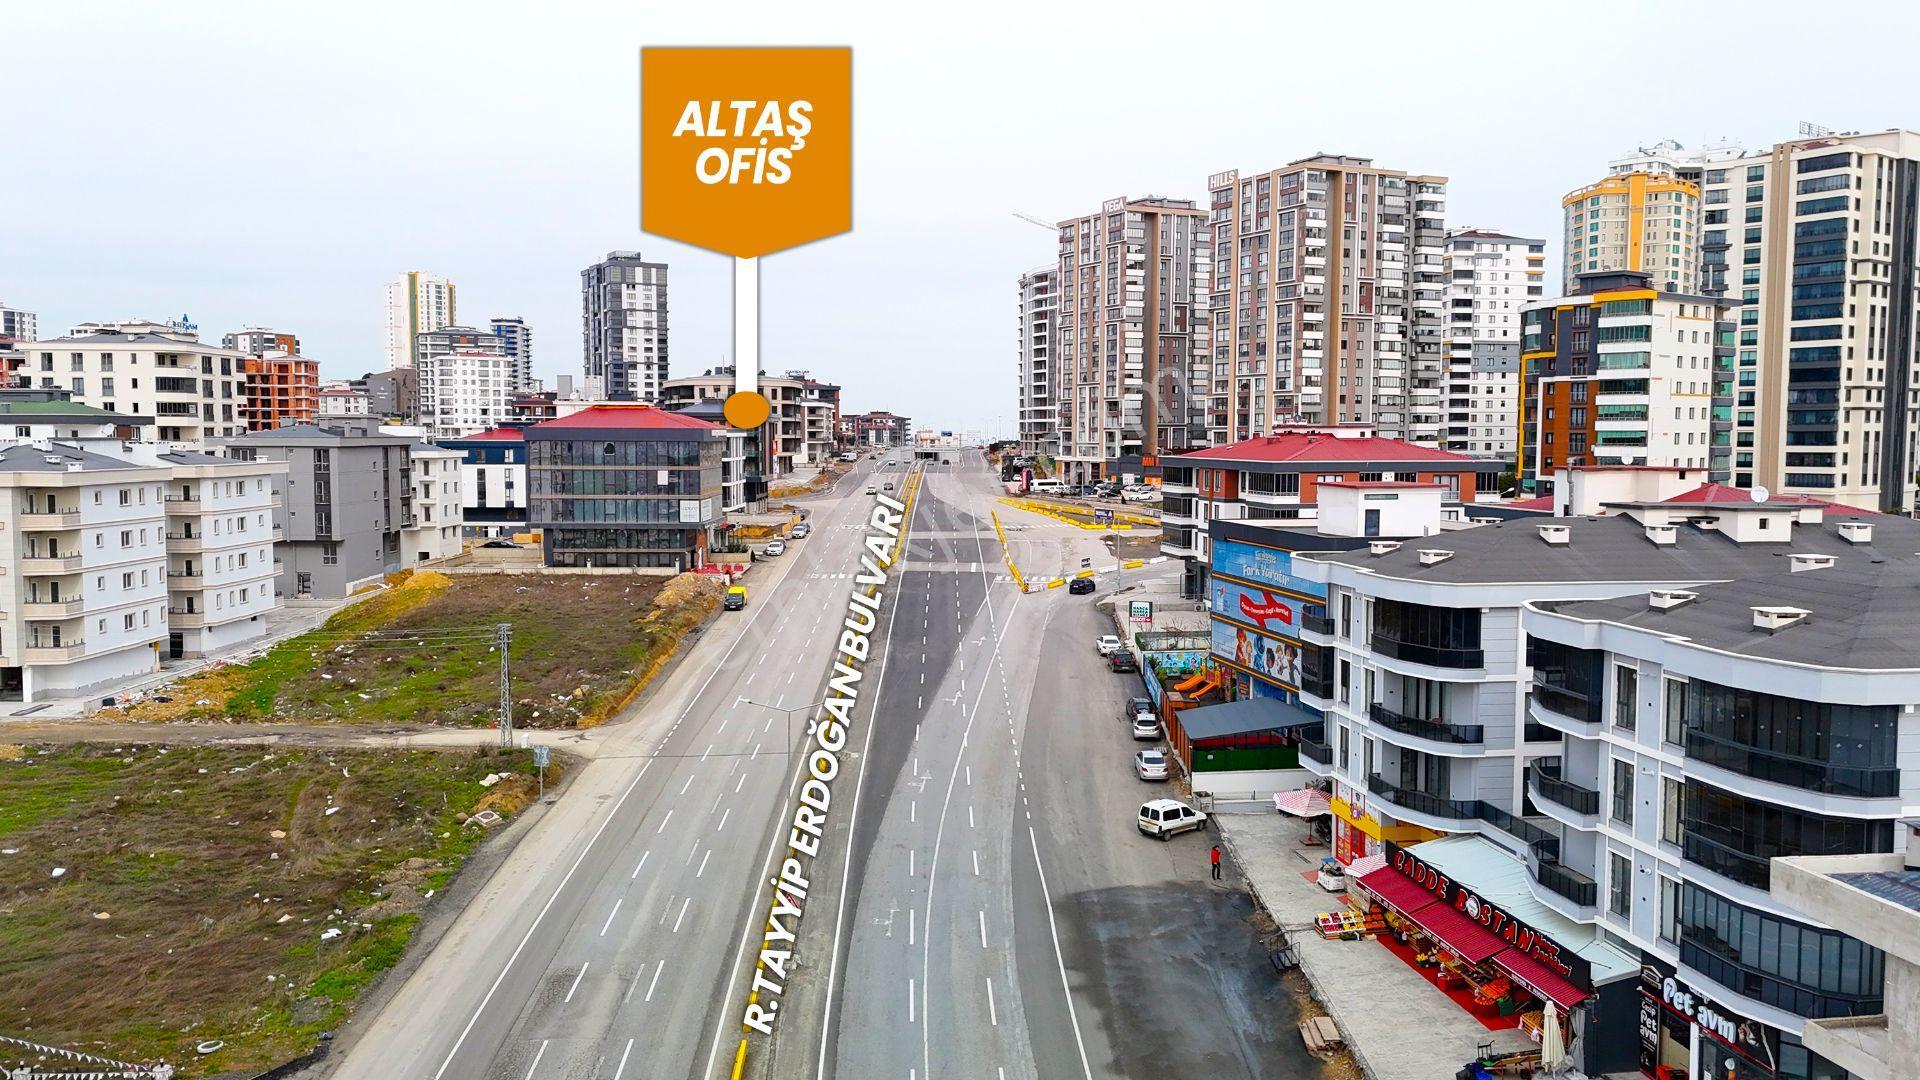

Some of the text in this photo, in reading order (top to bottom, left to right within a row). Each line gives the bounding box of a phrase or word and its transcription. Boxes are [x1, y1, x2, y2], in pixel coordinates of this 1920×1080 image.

[1210, 171, 1235, 189] HILLS
[1104, 198, 1124, 212] VEGA
[1455, 888, 1535, 953] BOSTAN
[1640, 1009, 1657, 1032] Pet
[1663, 977, 1695, 1016] Pet
[1697, 1005, 1737, 1044] avm
[1640, 1024, 1658, 1045] avm
